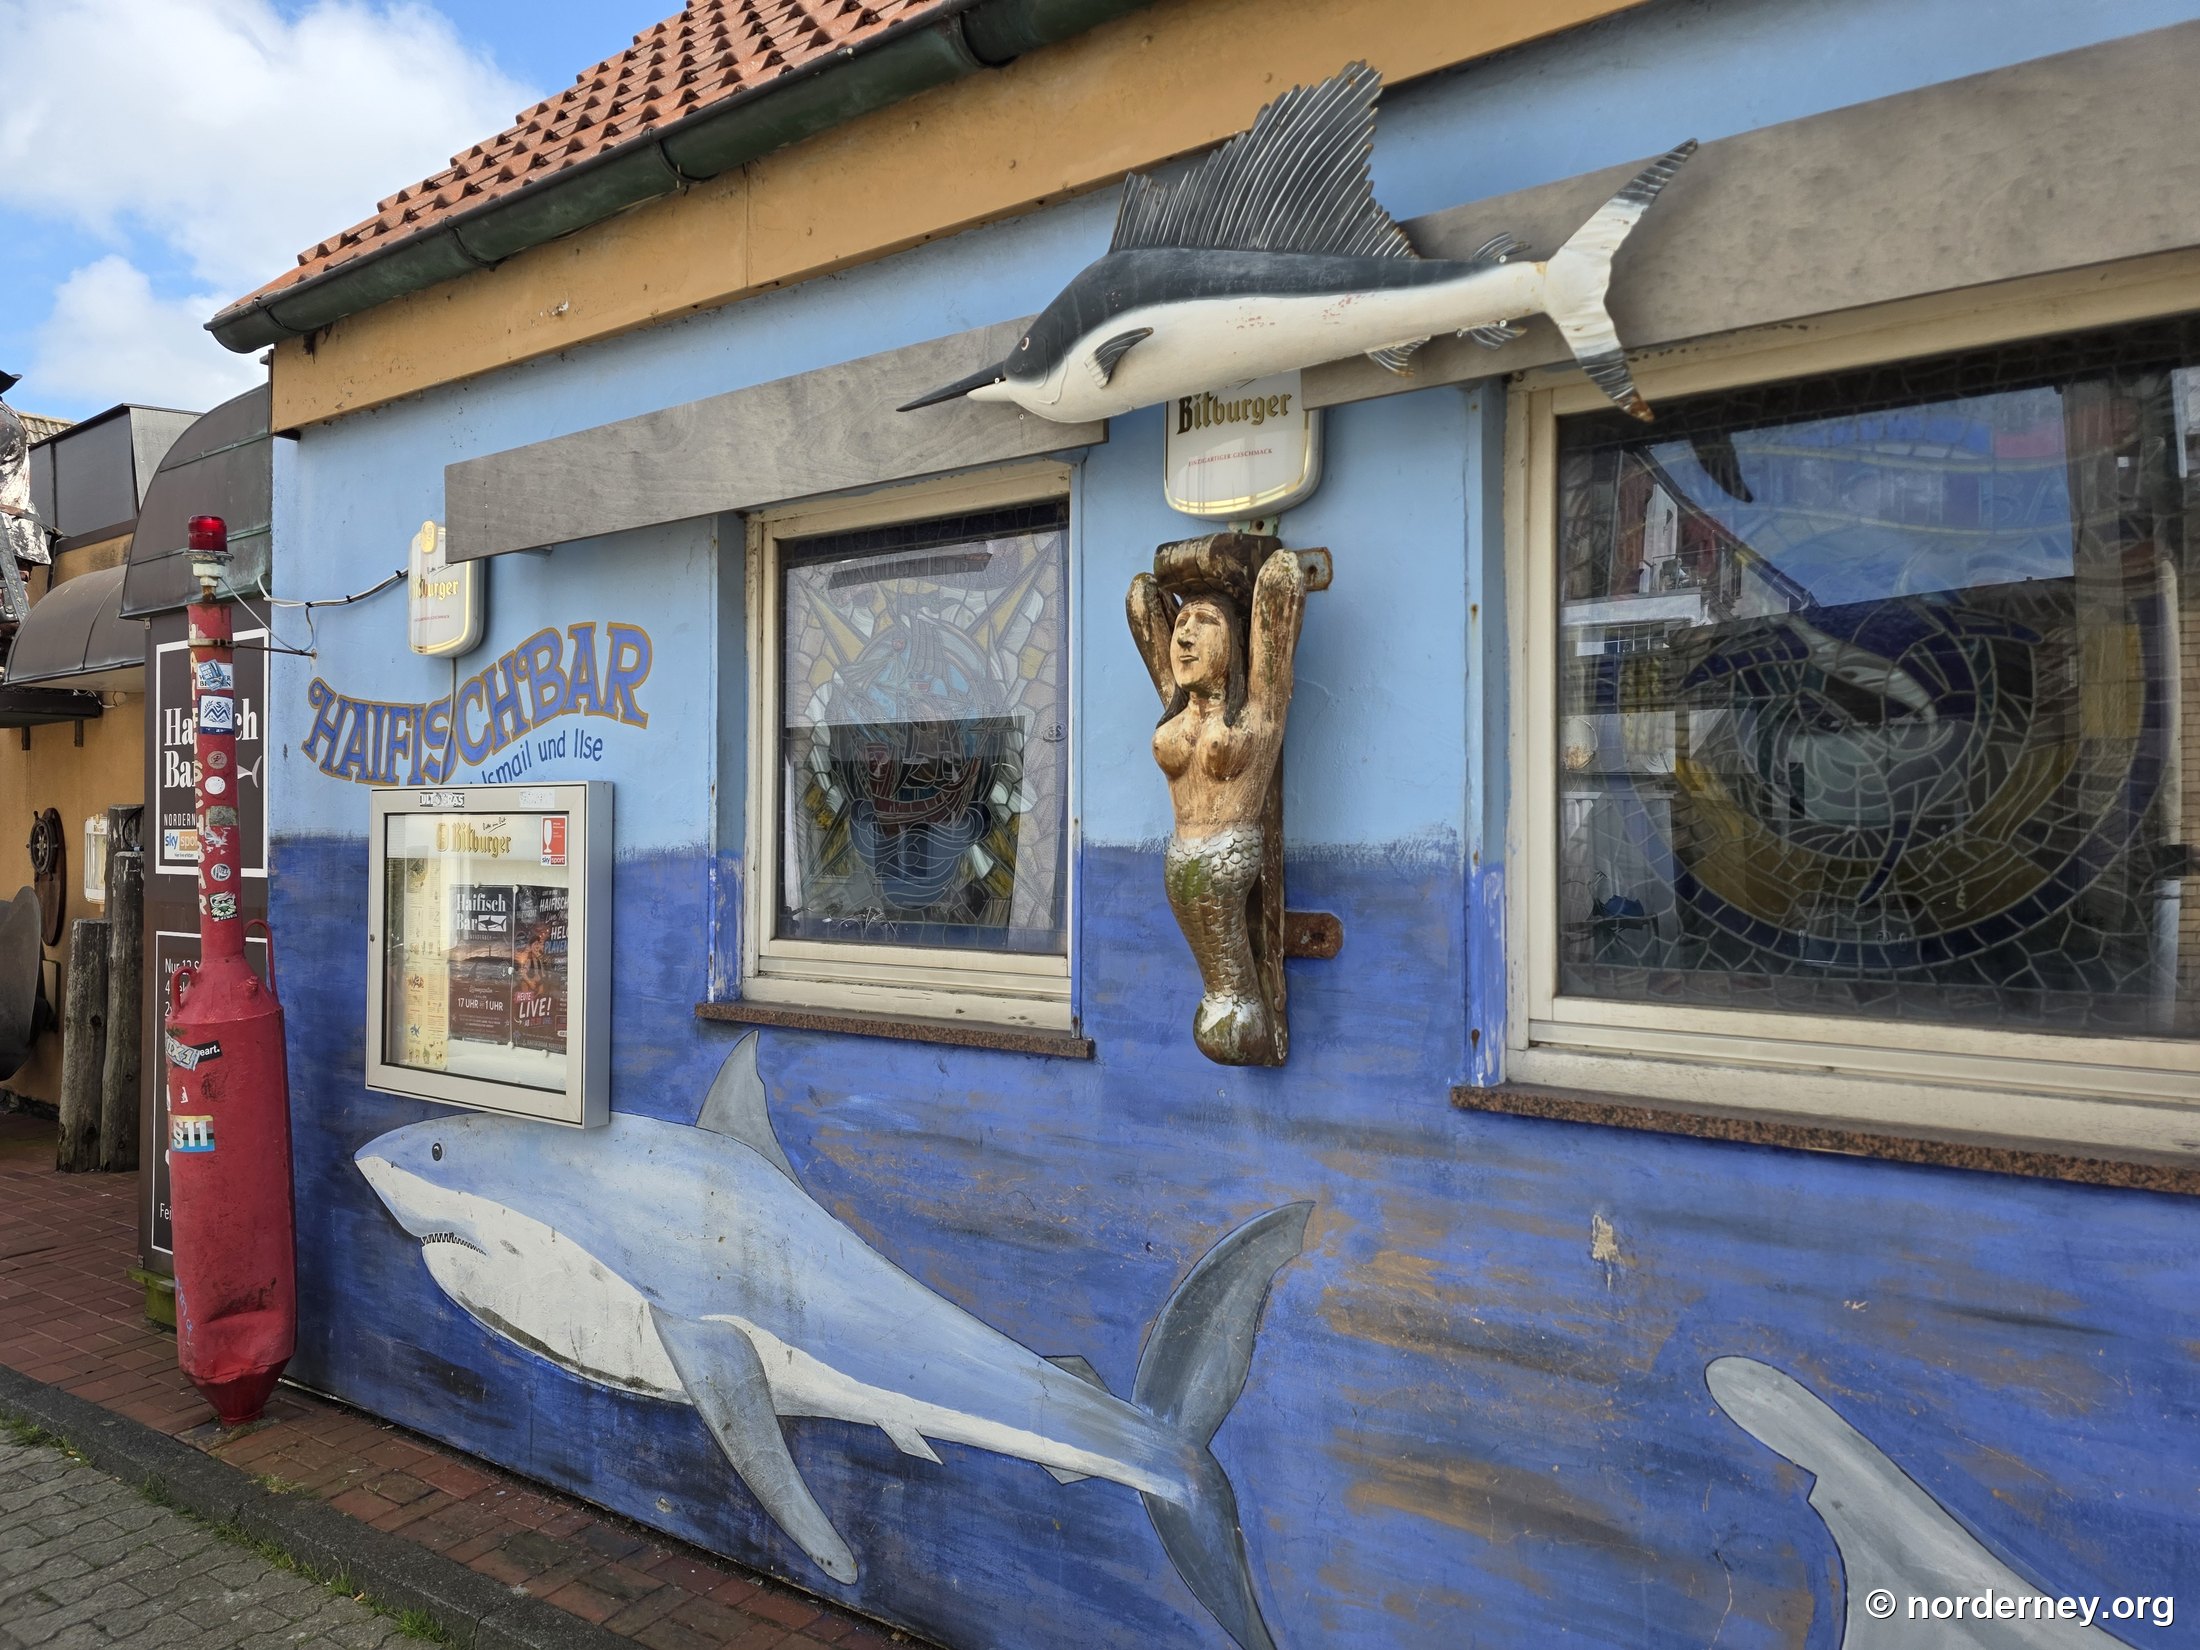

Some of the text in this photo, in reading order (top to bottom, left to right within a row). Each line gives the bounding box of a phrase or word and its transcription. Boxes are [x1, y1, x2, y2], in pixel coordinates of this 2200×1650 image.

[1176, 391, 1292, 435] Bitburger
[1233, 448, 1273, 459] GESCHMACK
[537, 730, 566, 762] und
[574, 728, 603, 762] Ilse
[164, 813, 196, 827] NORDERN
[165, 833, 179, 849] sky
[451, 822, 512, 858] Bitburger
[541, 856, 565, 866] sky sport
[456, 893, 506, 912] Haifisch
[456, 912, 477, 930] Bar
[551, 926, 568, 940] HEL
[458, 997, 464, 1008] 17
[465, 999, 479, 1009] UHR
[490, 1000, 504, 1011] UHR
[520, 997, 551, 1019] LIVE!
